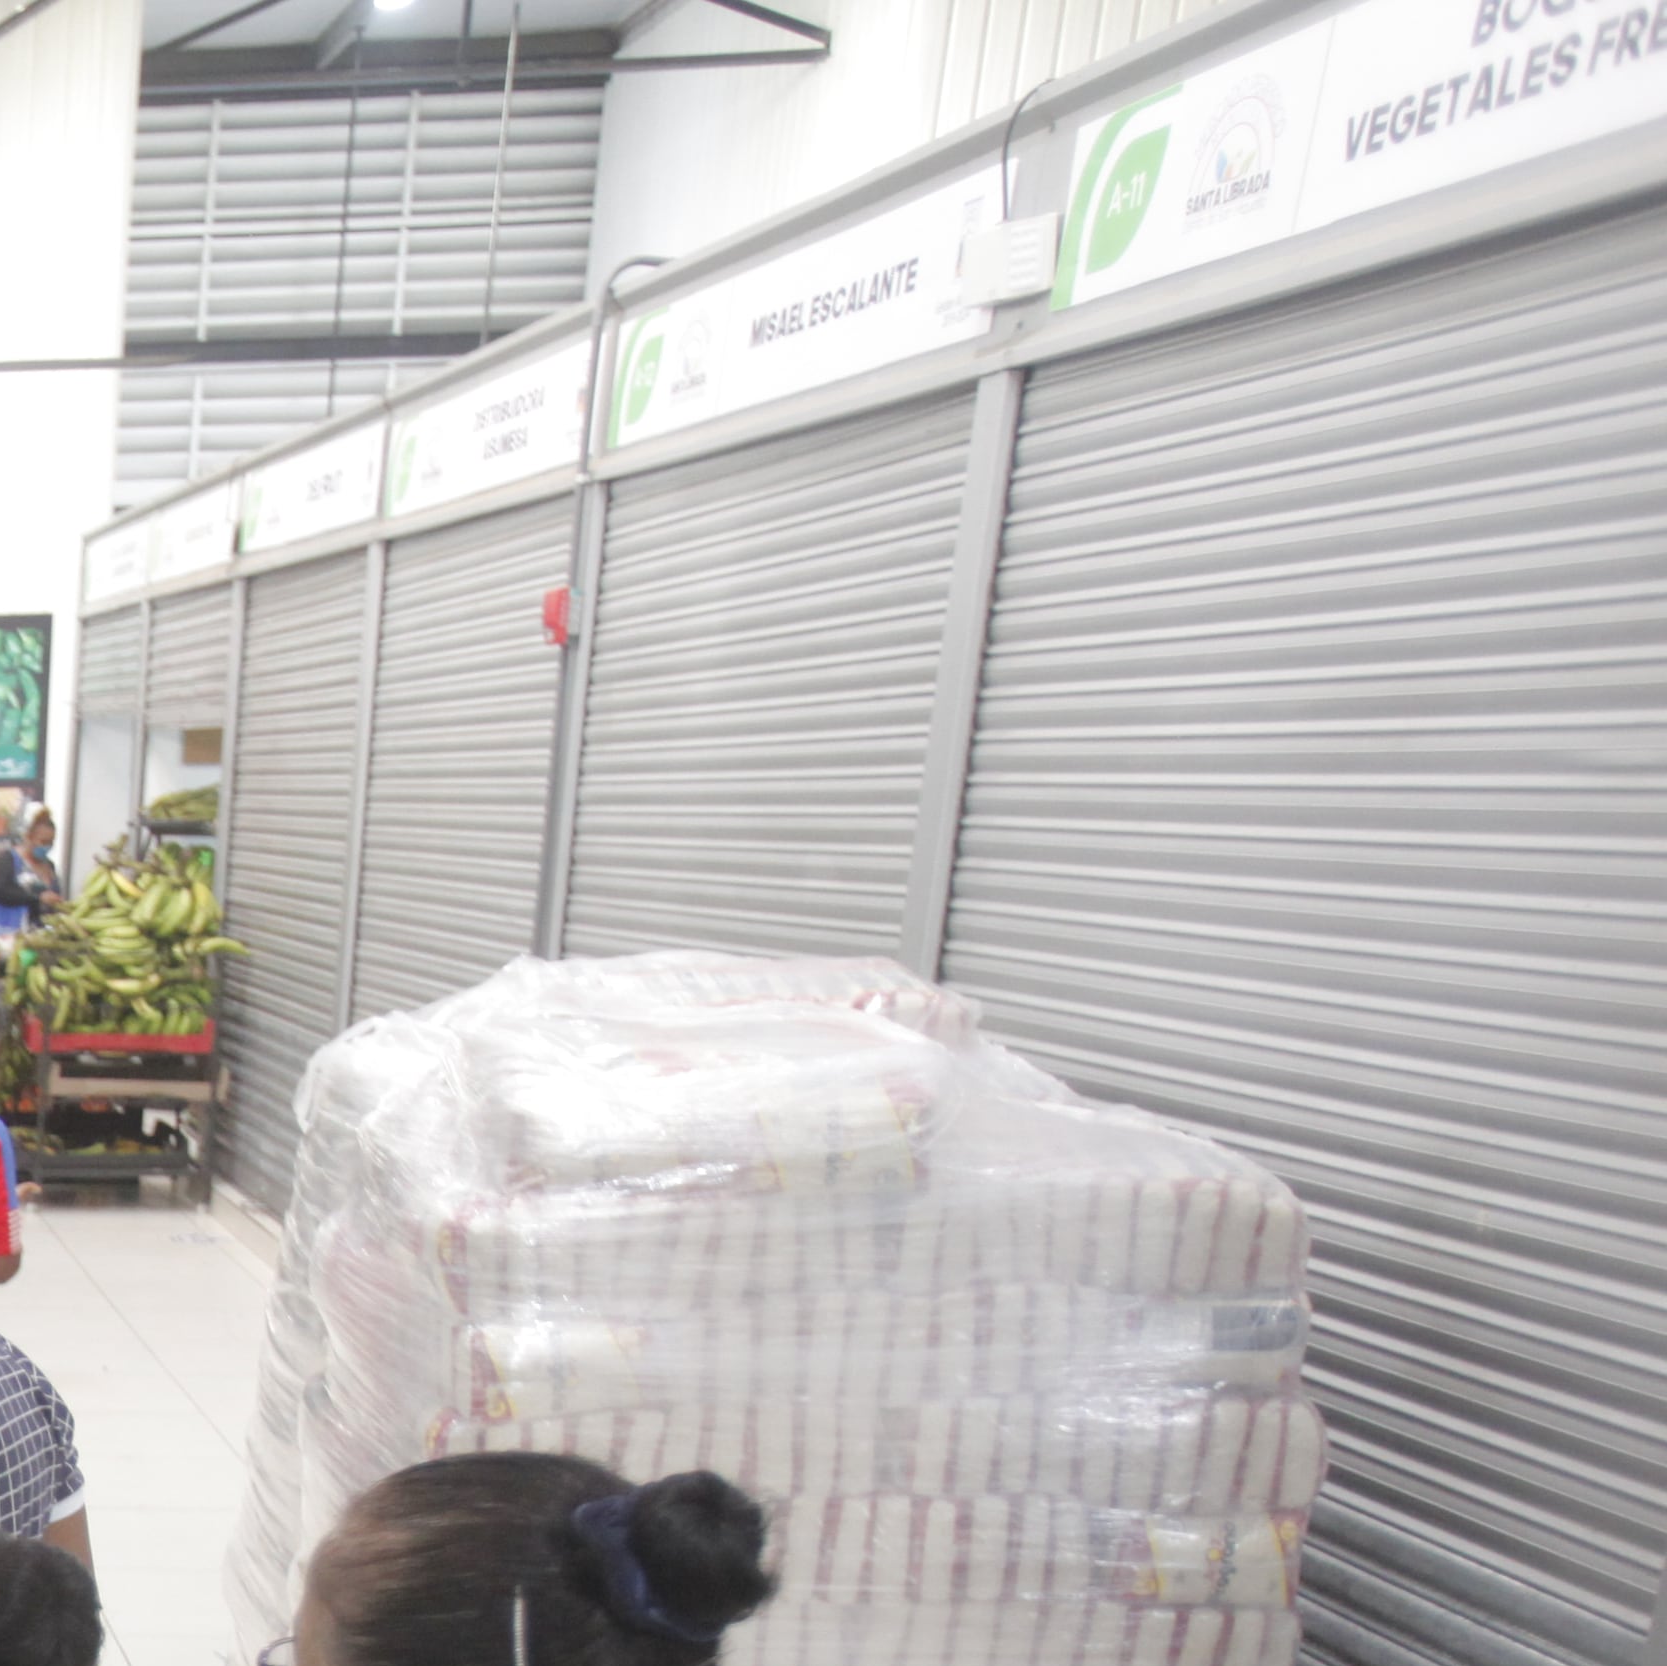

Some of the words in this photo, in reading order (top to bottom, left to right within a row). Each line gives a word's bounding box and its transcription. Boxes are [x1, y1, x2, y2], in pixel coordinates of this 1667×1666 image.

[1471, 0, 1596, 48] BO
[1345, 31, 1582, 162] VEGETALES
[1586, 0, 1667, 77] FRE
[1107, 172, 1146, 219] A-11
[1185, 188, 1222, 216] SANTA
[1223, 170, 1271, 206] LIBRADA
[749, 301, 805, 349] MISAEL
[808, 257, 919, 327] ESCALANTE
